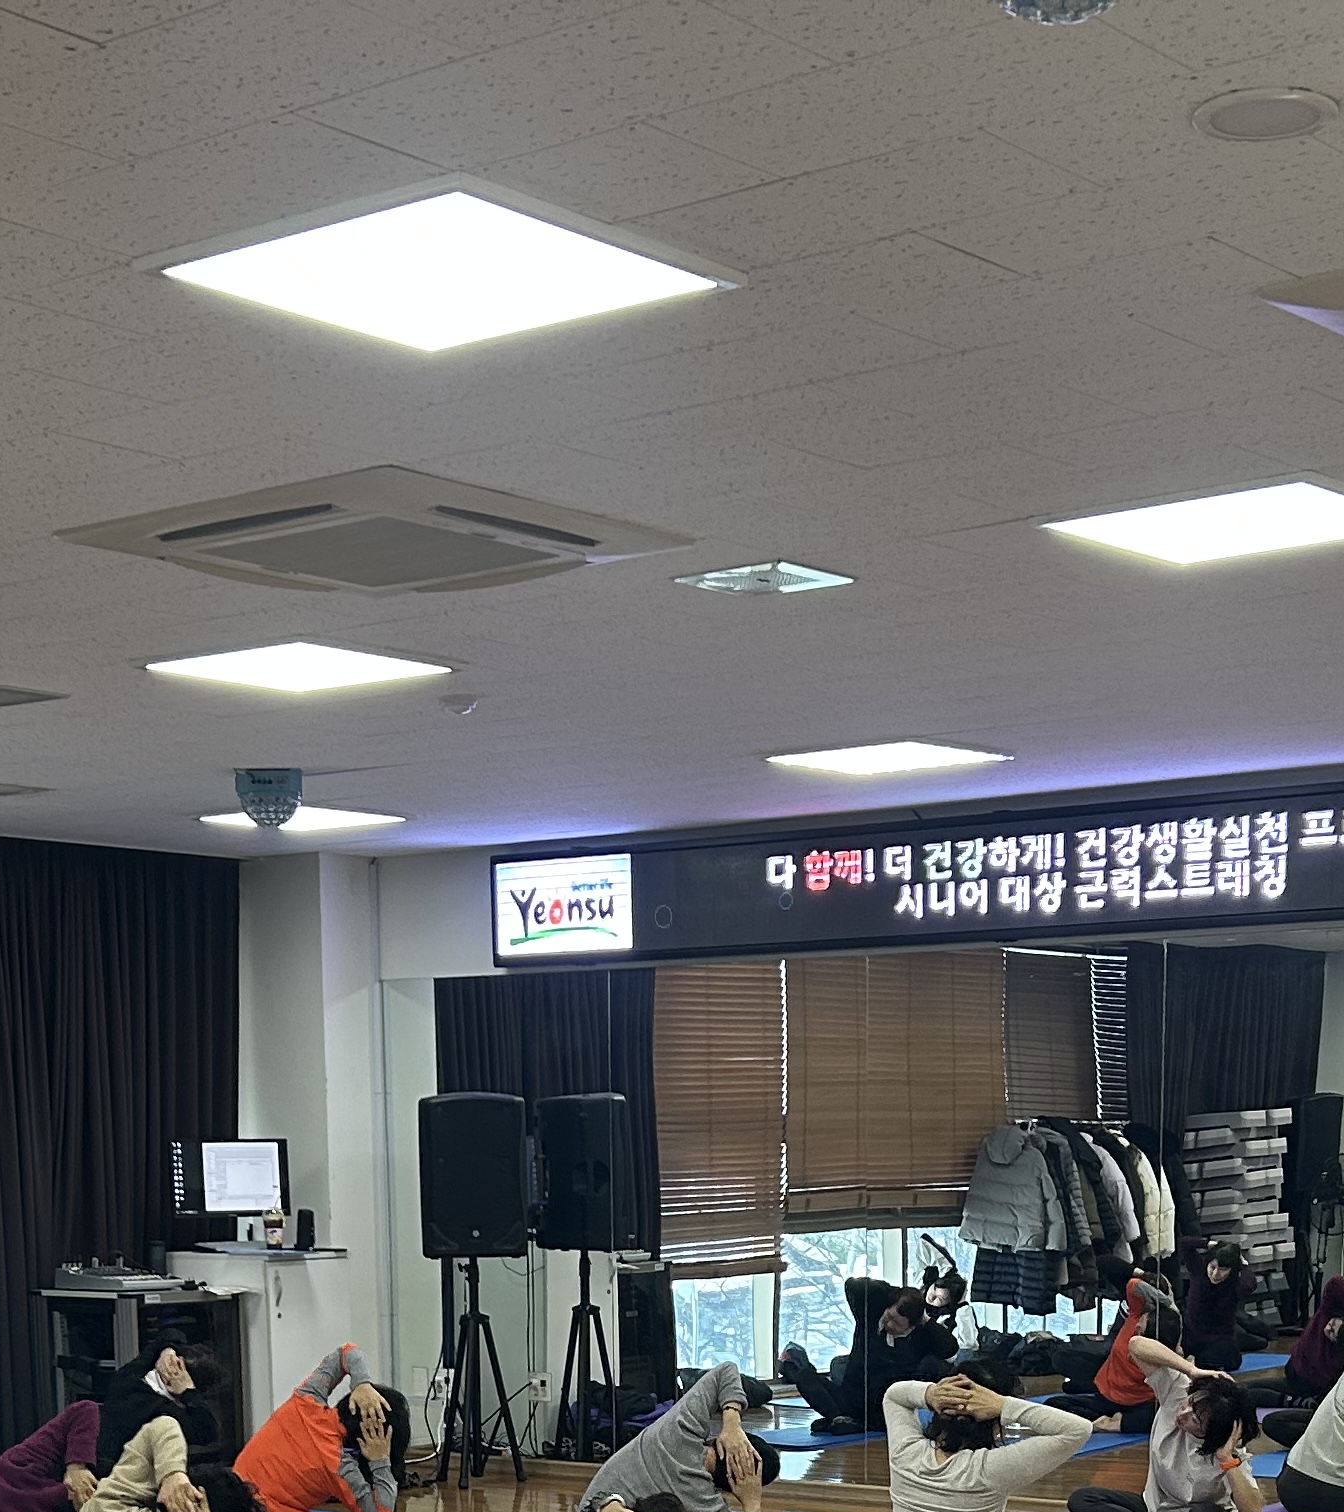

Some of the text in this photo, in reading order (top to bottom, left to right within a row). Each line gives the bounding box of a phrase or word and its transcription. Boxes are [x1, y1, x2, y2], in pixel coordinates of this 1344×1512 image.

[765, 853, 797, 891] 다
[803, 848, 876, 892] 함께!
[882, 844, 913, 881] 더
[922, 831, 1066, 881] 건강하게!
[1073, 809, 1290, 869] 건강생활실천
[509, 886, 615, 938] Yeonsu
[893, 854, 1289, 919] 시니어 대상 근력스트레칭
